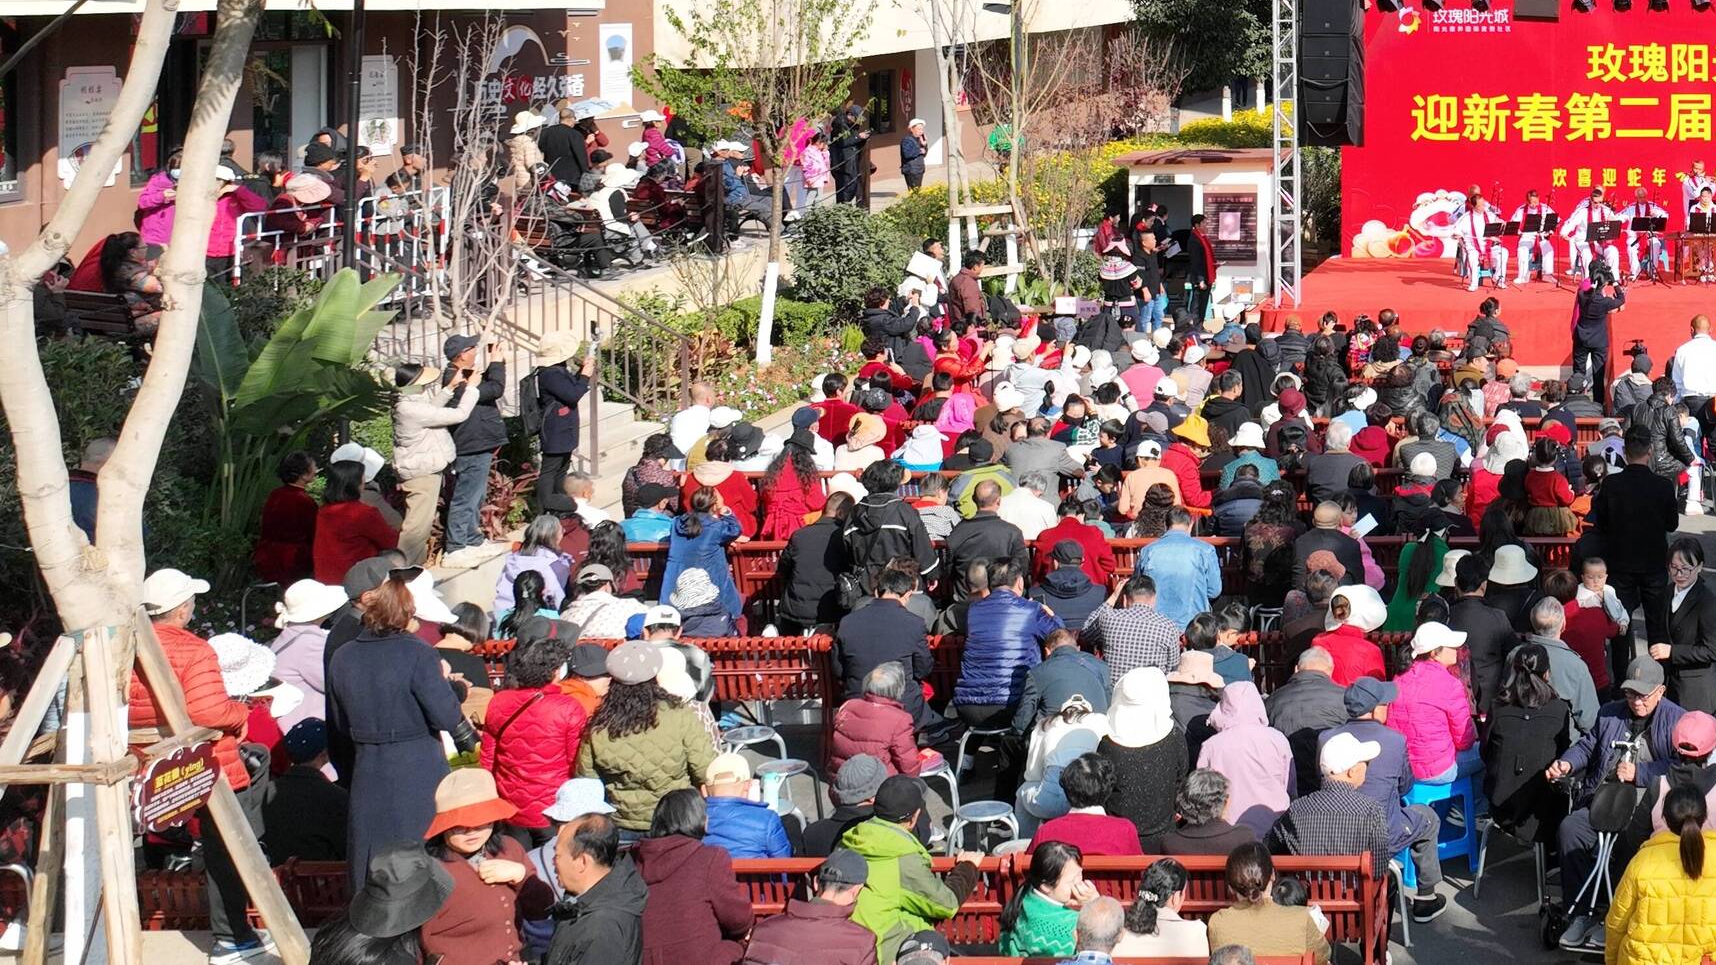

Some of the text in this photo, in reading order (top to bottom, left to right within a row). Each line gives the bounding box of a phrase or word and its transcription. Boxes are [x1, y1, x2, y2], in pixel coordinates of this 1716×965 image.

[1432, 8, 1509, 24] 玫瑰阳光城
